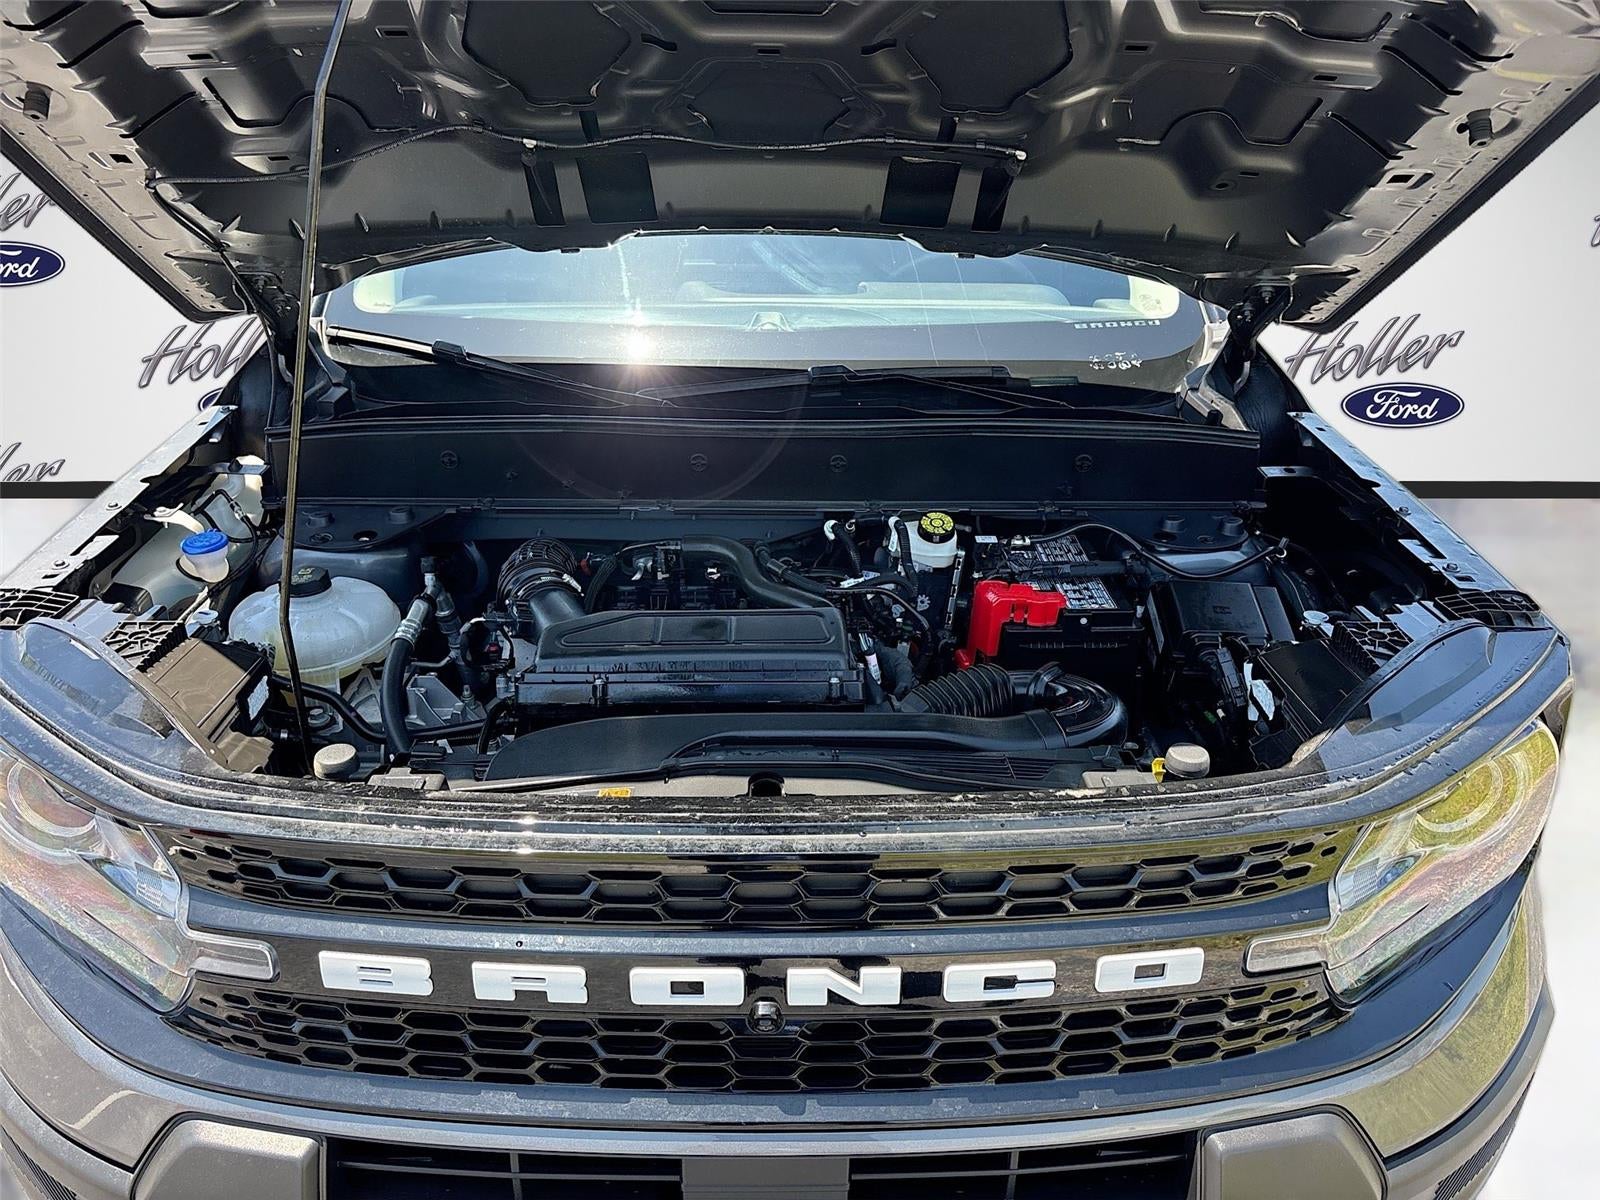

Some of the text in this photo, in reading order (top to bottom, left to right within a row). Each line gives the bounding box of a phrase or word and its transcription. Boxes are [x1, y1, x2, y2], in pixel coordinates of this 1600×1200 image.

[0, 250, 41, 278] rd
[1285, 313, 1465, 385] Holler
[1366, 389, 1440, 420] Ford
[318, 946, 1205, 1007] BRONCO
